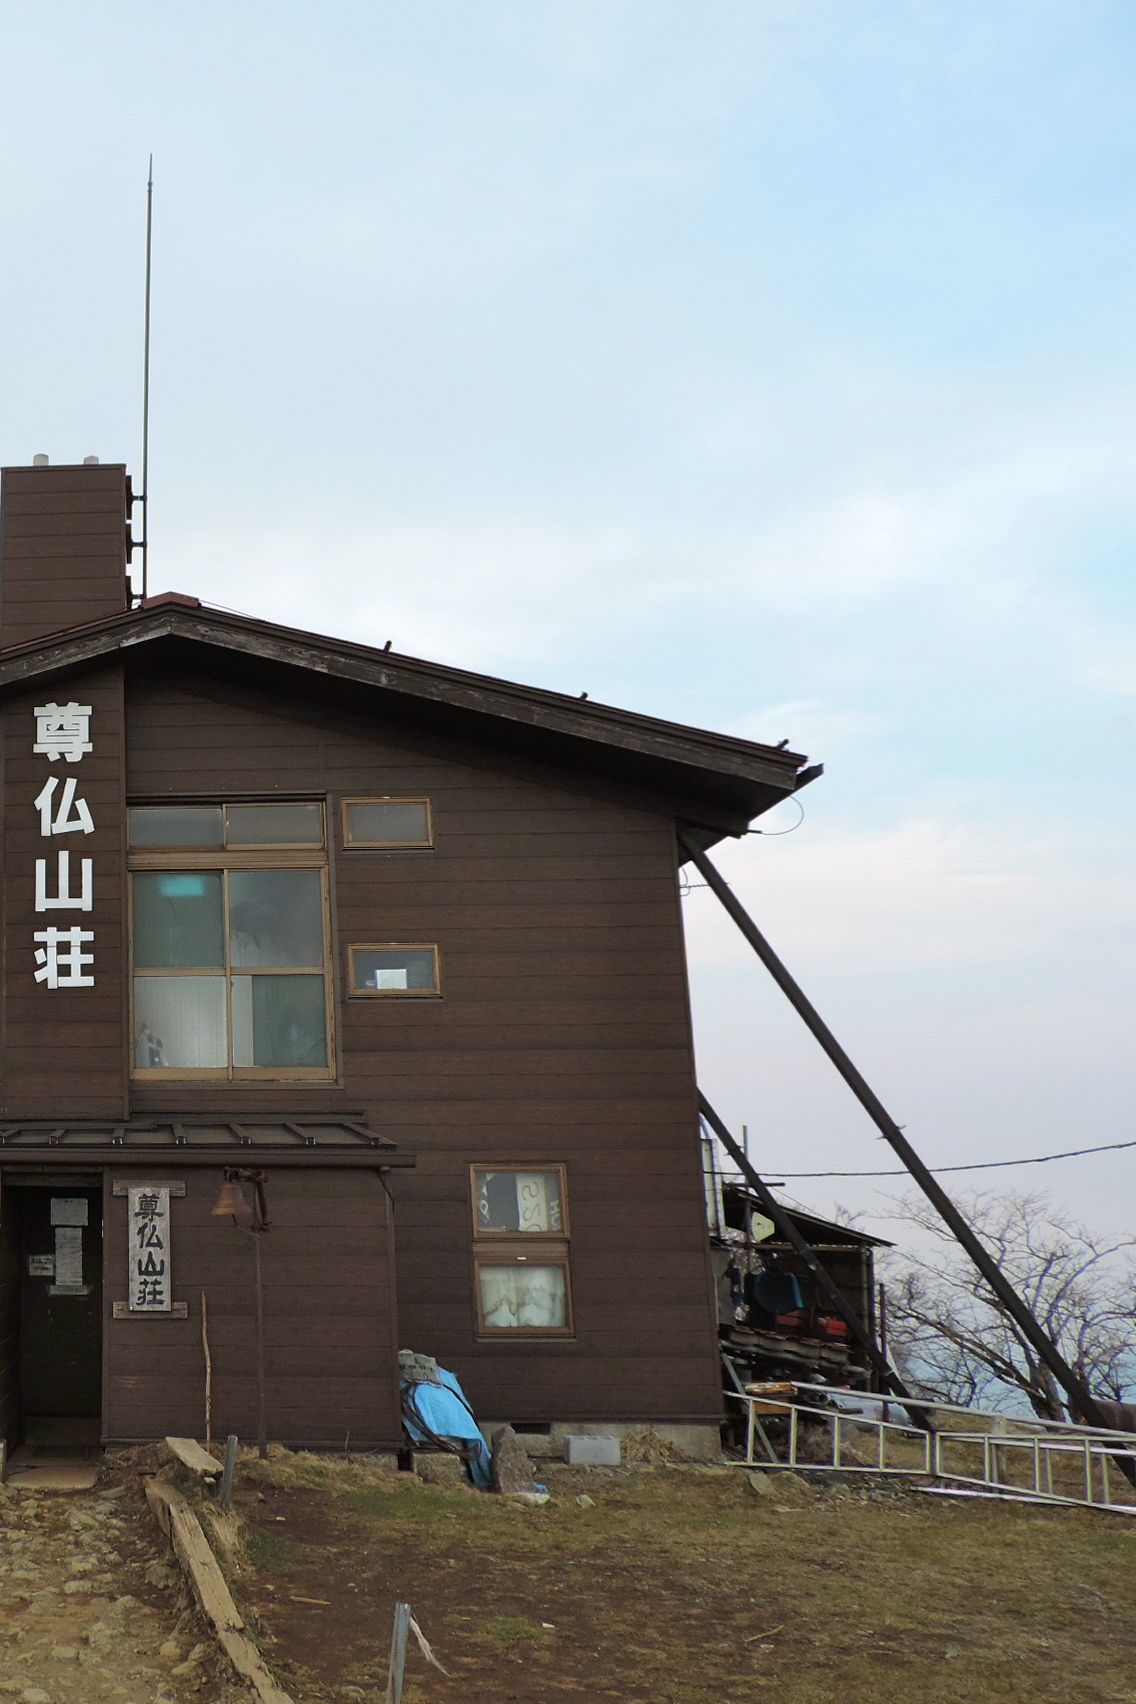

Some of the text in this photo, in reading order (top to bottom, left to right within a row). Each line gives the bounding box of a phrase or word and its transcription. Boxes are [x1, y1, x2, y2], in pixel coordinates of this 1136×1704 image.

[32, 701, 96, 990] 尊仏山荘
[133, 1193, 166, 1306] 尊仏山荘
